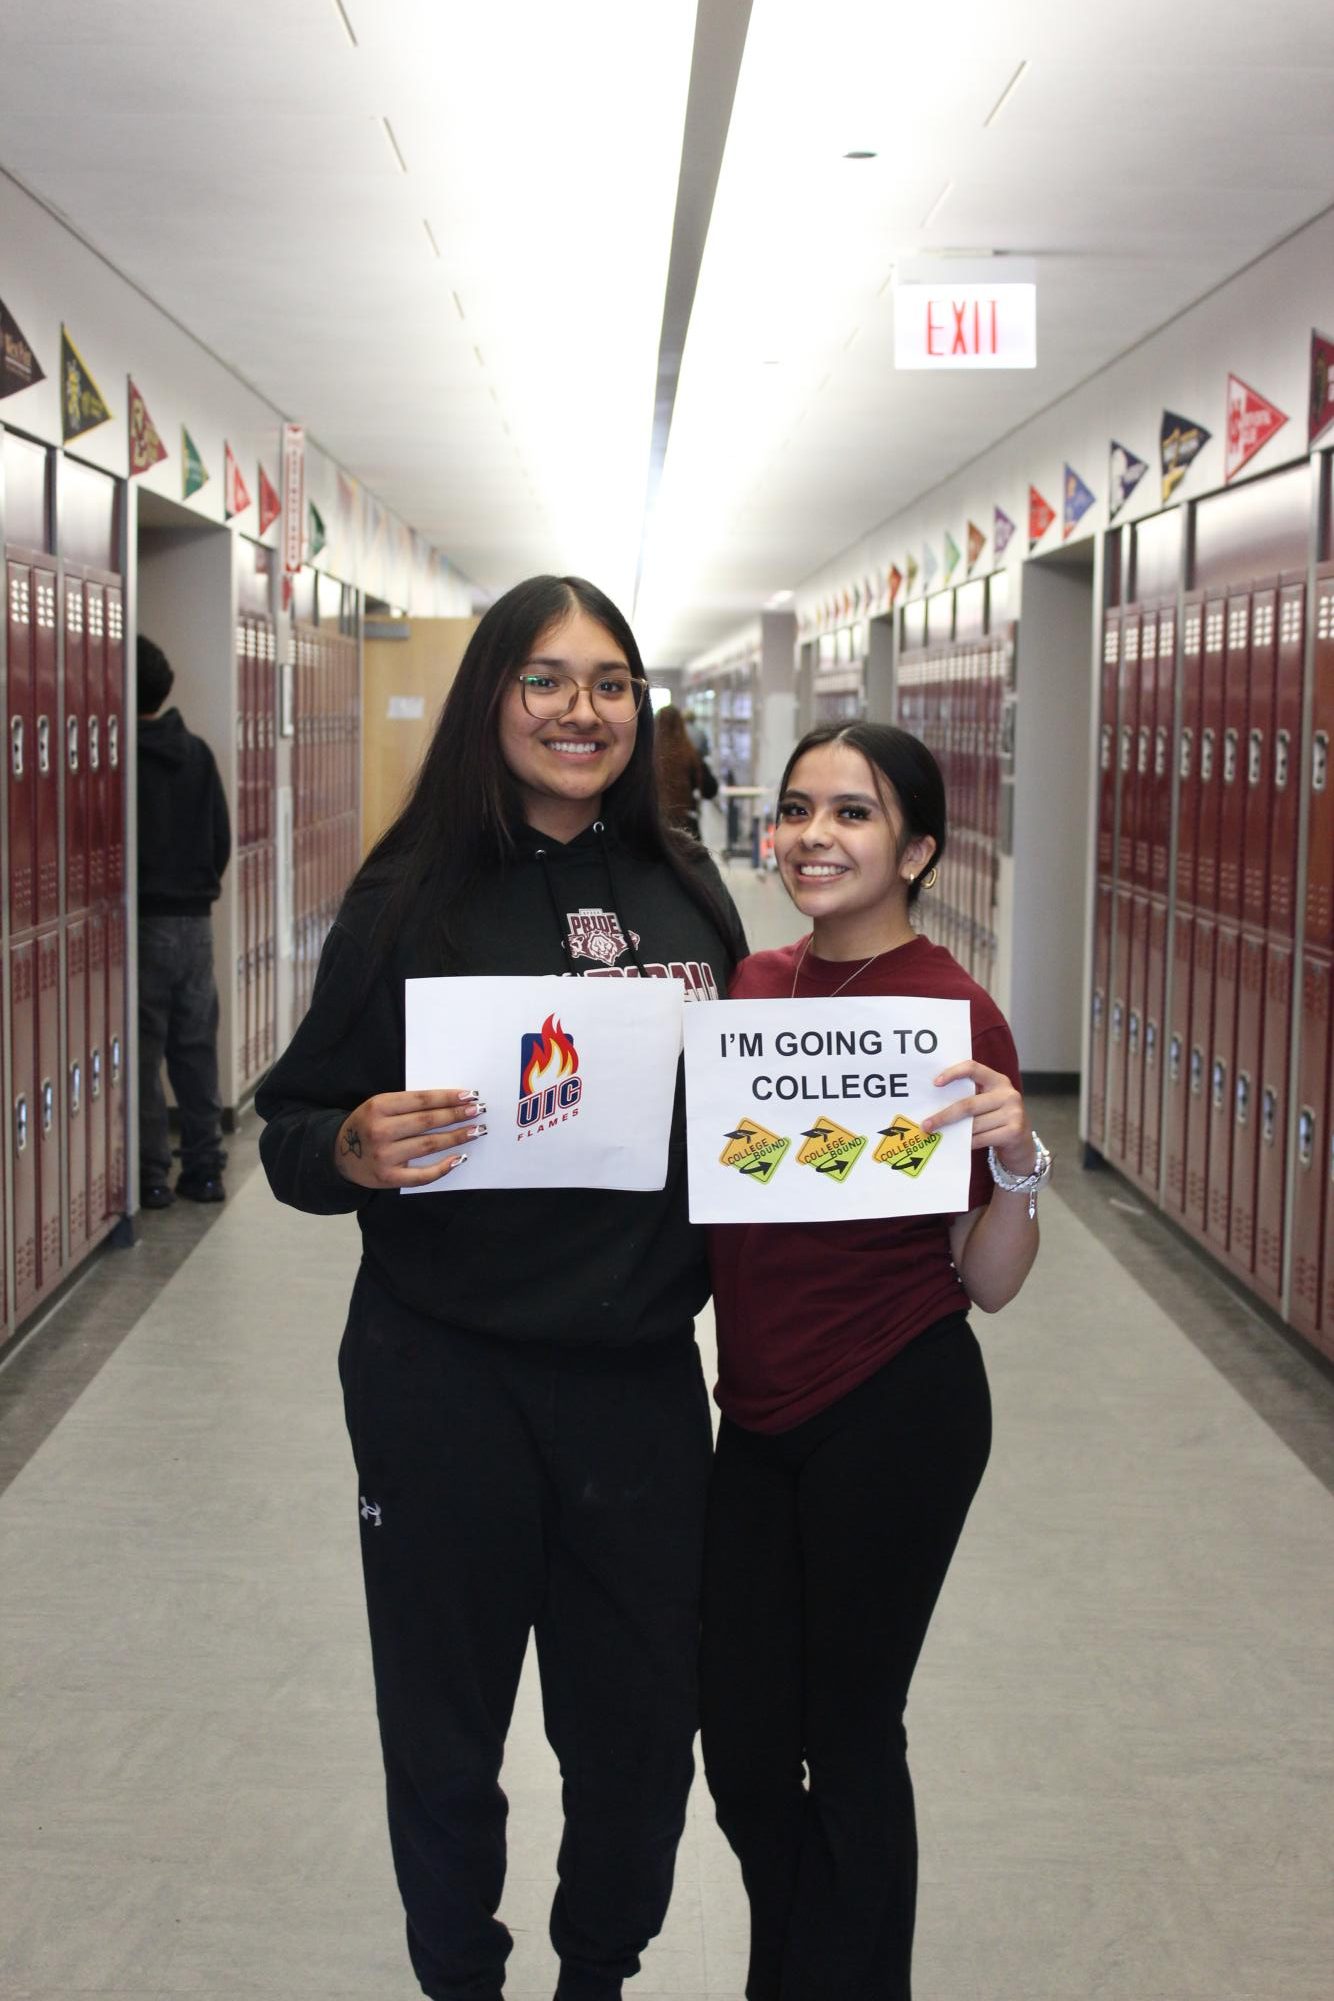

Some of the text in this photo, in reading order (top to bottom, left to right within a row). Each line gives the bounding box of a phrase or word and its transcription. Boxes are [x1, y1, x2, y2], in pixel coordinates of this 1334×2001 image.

[926, 299, 998, 356] EXIT
[570, 914, 621, 936] PRIDE
[720, 1029, 938, 1057] I'M GOING TO
[751, 1073, 909, 1101] COLLEGE
[516, 1076, 583, 1129] UIC
[516, 1108, 580, 1142] FLAMES
[727, 1138, 769, 1165] COLLEGE
[752, 1138, 786, 1161] BOUND
[804, 1136, 846, 1164] COLLEGE
[830, 1137, 862, 1159] BOUND
[880, 1134, 922, 1162] COLLEGE
[905, 1133, 937, 1156] BOUND
